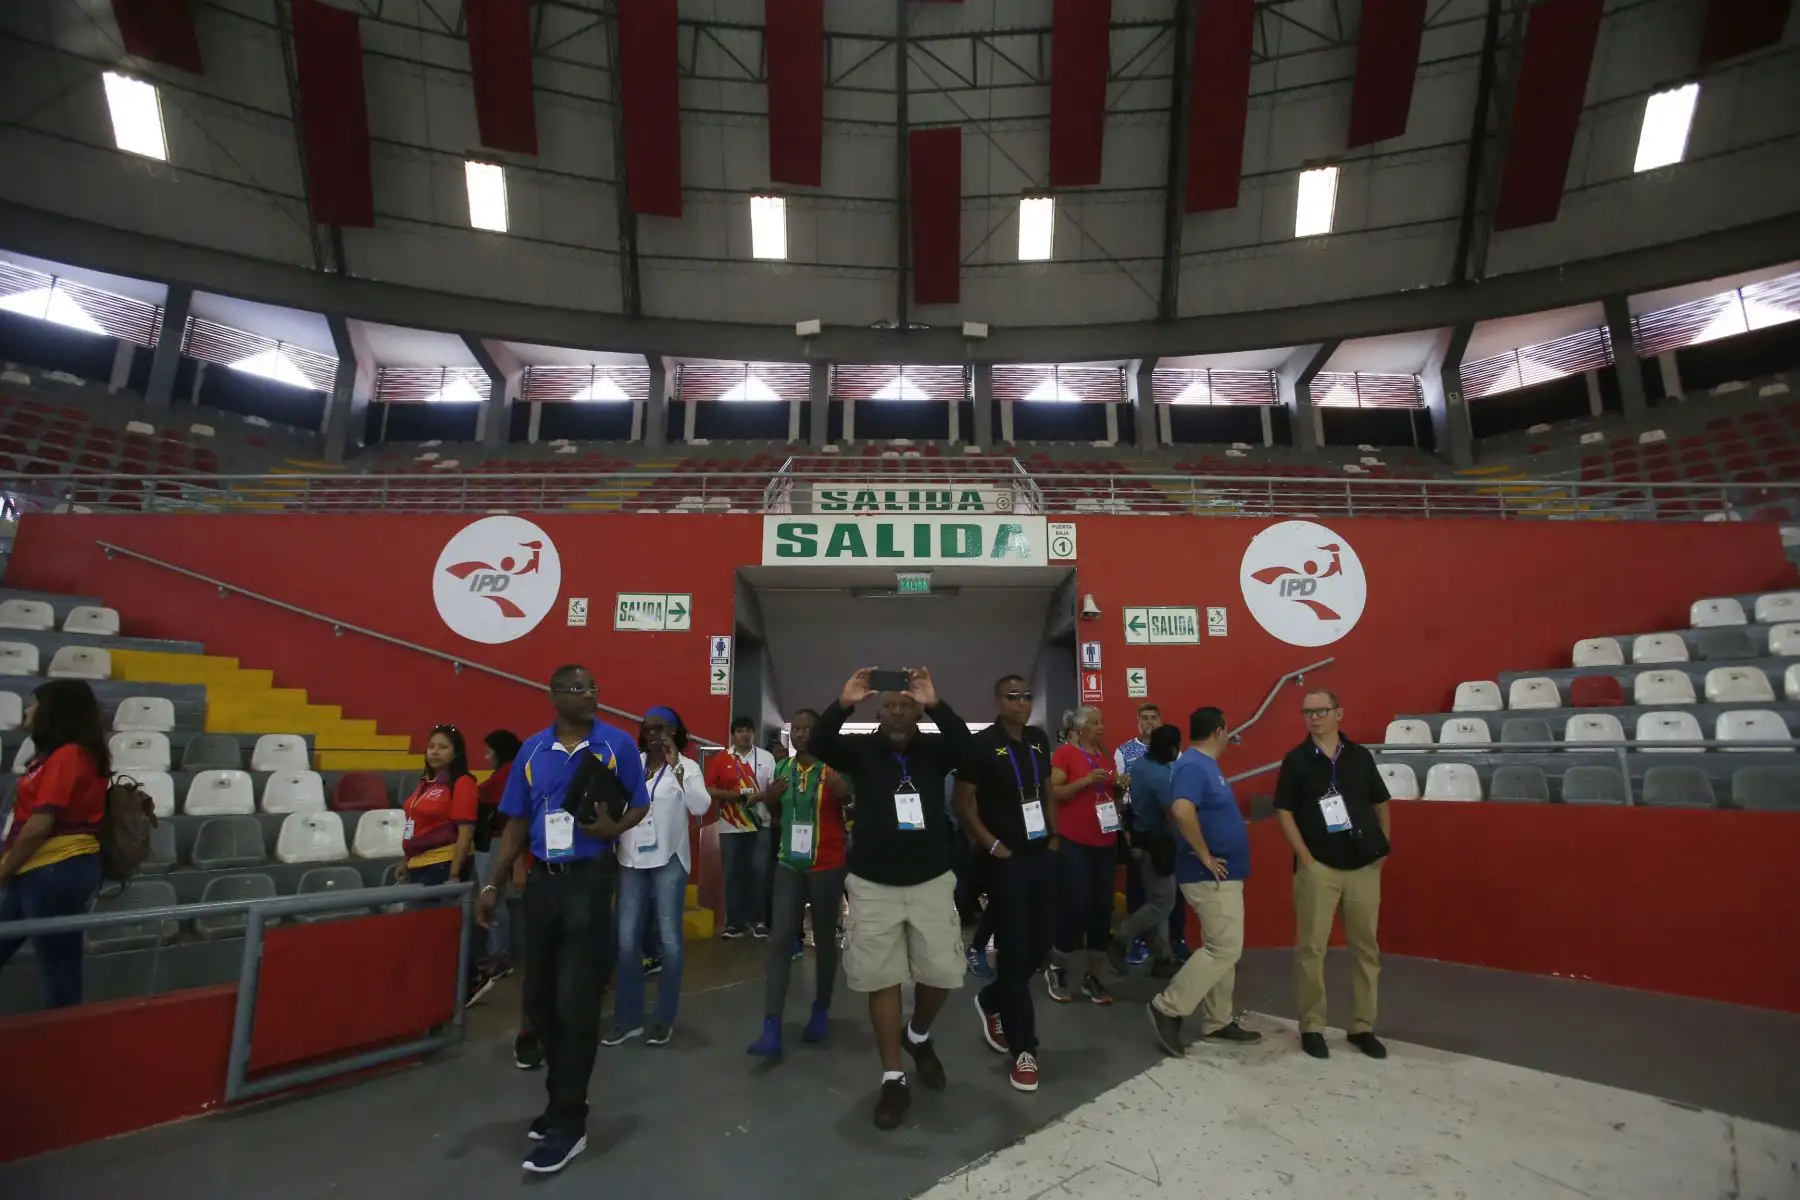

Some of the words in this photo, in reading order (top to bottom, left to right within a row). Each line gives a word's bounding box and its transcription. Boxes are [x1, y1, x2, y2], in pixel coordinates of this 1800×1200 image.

[821, 489, 985, 510] SALIDA
[776, 523, 1033, 558] SALIDA
[1059, 541, 1066, 552] 1
[469, 574, 511, 592] IPD
[899, 579, 928, 592] SALIDA
[1279, 578, 1317, 597] IPD
[1151, 615, 1195, 636] SALIDA
